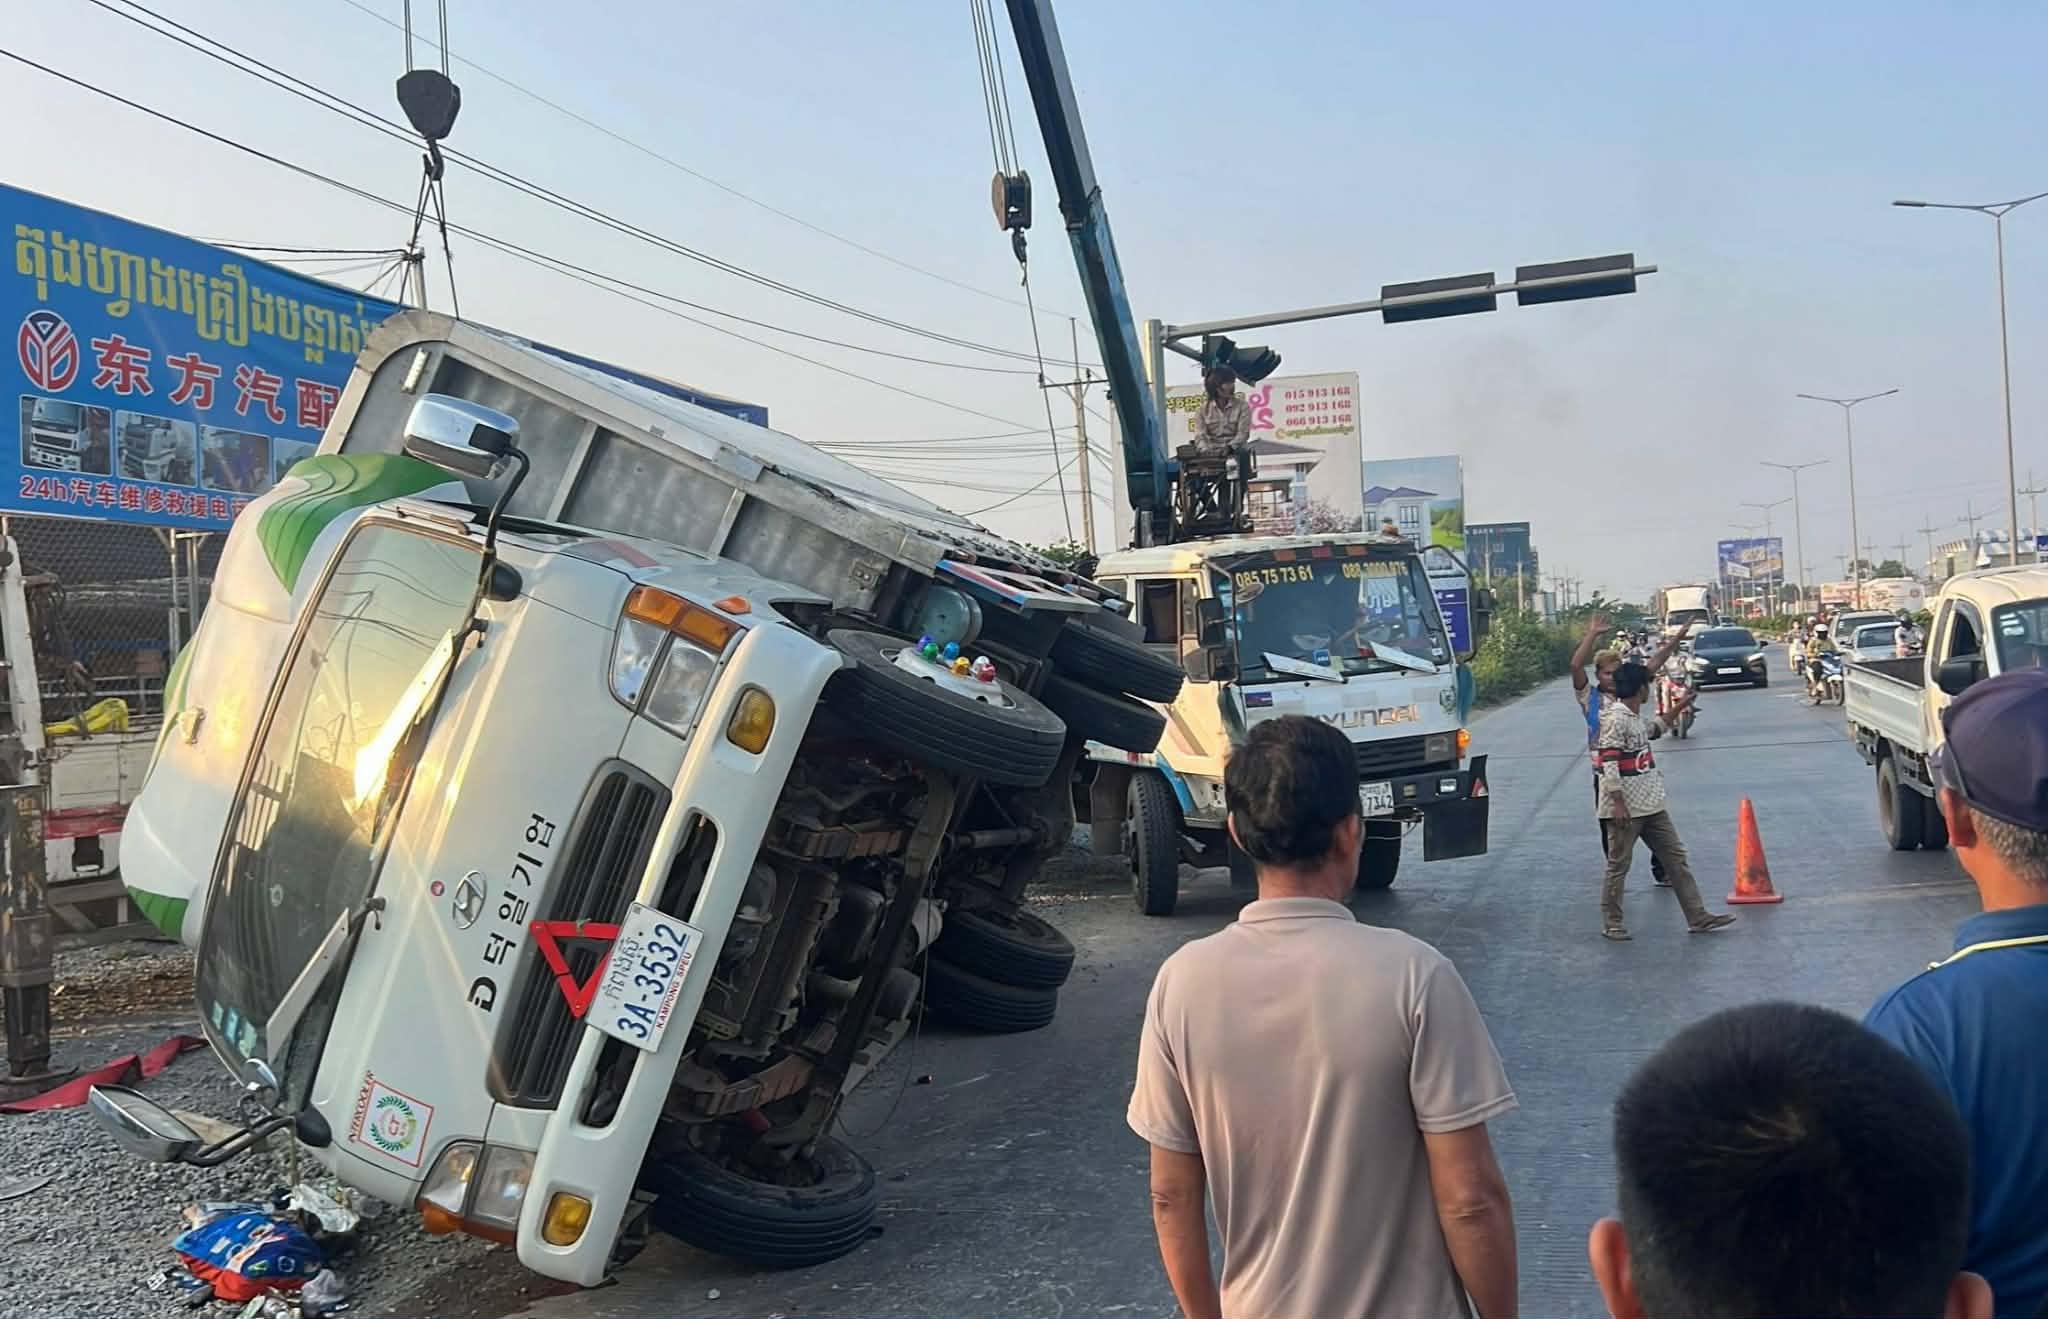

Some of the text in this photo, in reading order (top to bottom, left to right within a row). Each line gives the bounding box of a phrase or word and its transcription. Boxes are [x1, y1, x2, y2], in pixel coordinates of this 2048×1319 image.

[1235, 565, 1314, 588] 085 75 73 61
[1314, 703, 1419, 729] YUNDAI
[616, 923, 687, 1038] 3A-3532
[656, 952, 693, 1030] KAMPONG SPEU
